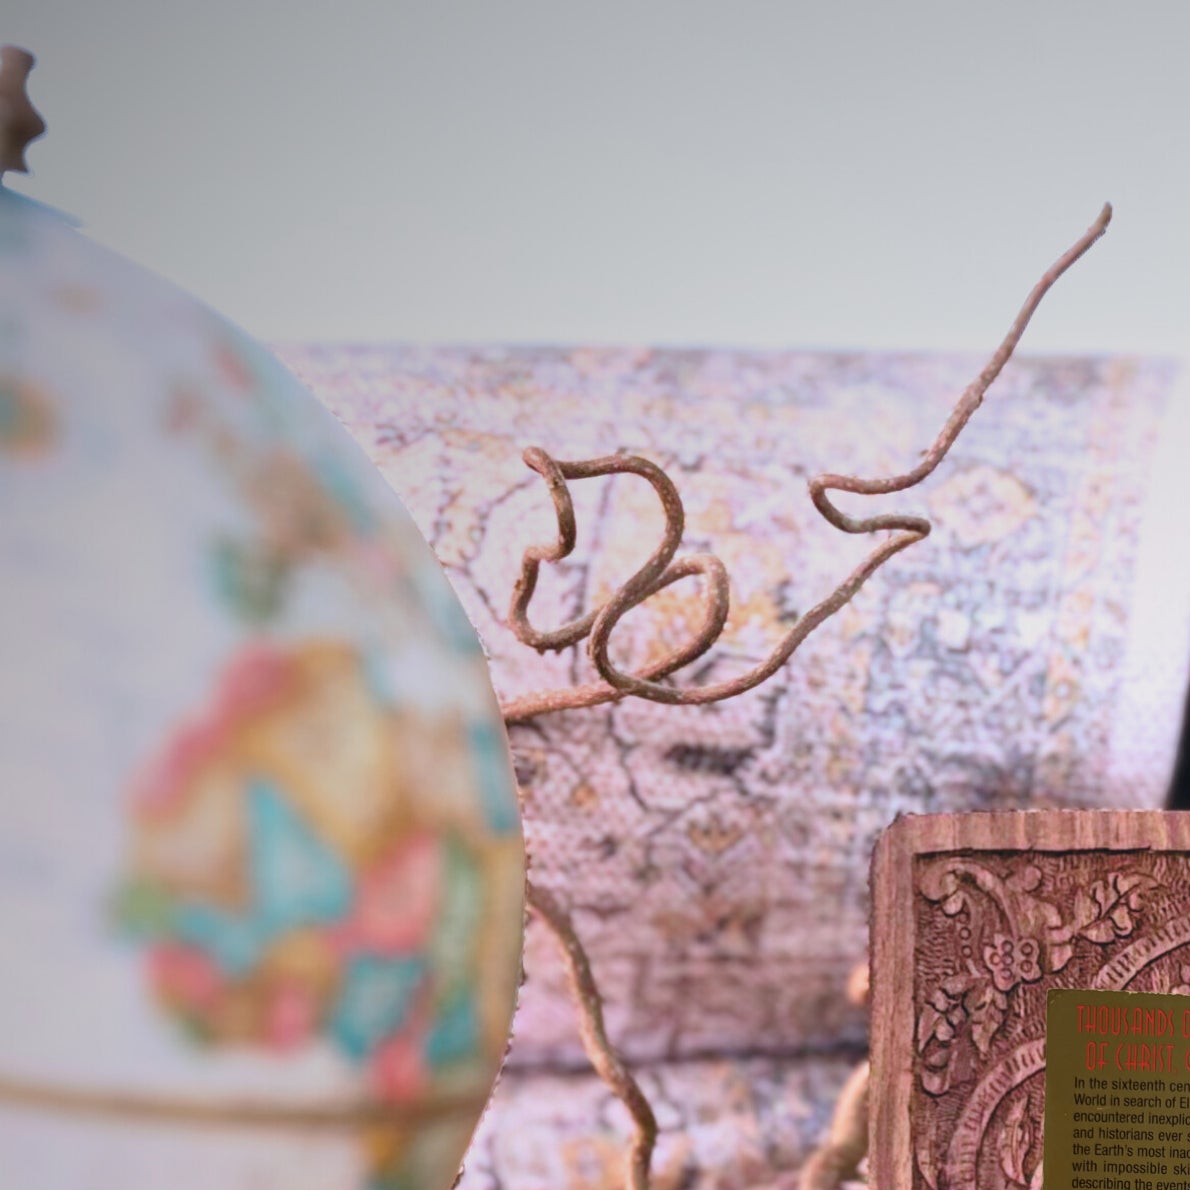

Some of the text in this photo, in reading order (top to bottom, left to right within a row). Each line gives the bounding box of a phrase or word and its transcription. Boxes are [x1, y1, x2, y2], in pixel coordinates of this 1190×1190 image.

[1076, 1004, 1174, 1037] THOUSANDS
[1085, 1041, 1109, 1071] OF
[1111, 1078, 1165, 1091] sixteenth
[1073, 1093, 1106, 1106] World
[1123, 1095, 1162, 1108] search
[1179, 1096, 1190, 1109] El
[1073, 1111, 1144, 1124] encountered
[1072, 1127, 1094, 1139] and
[1098, 1127, 1154, 1141] historians
[1158, 1131, 1183, 1142] ever
[1137, 1146, 1165, 1158] most
[1072, 1160, 1097, 1172] with
[1103, 1161, 1167, 1175] impossible
